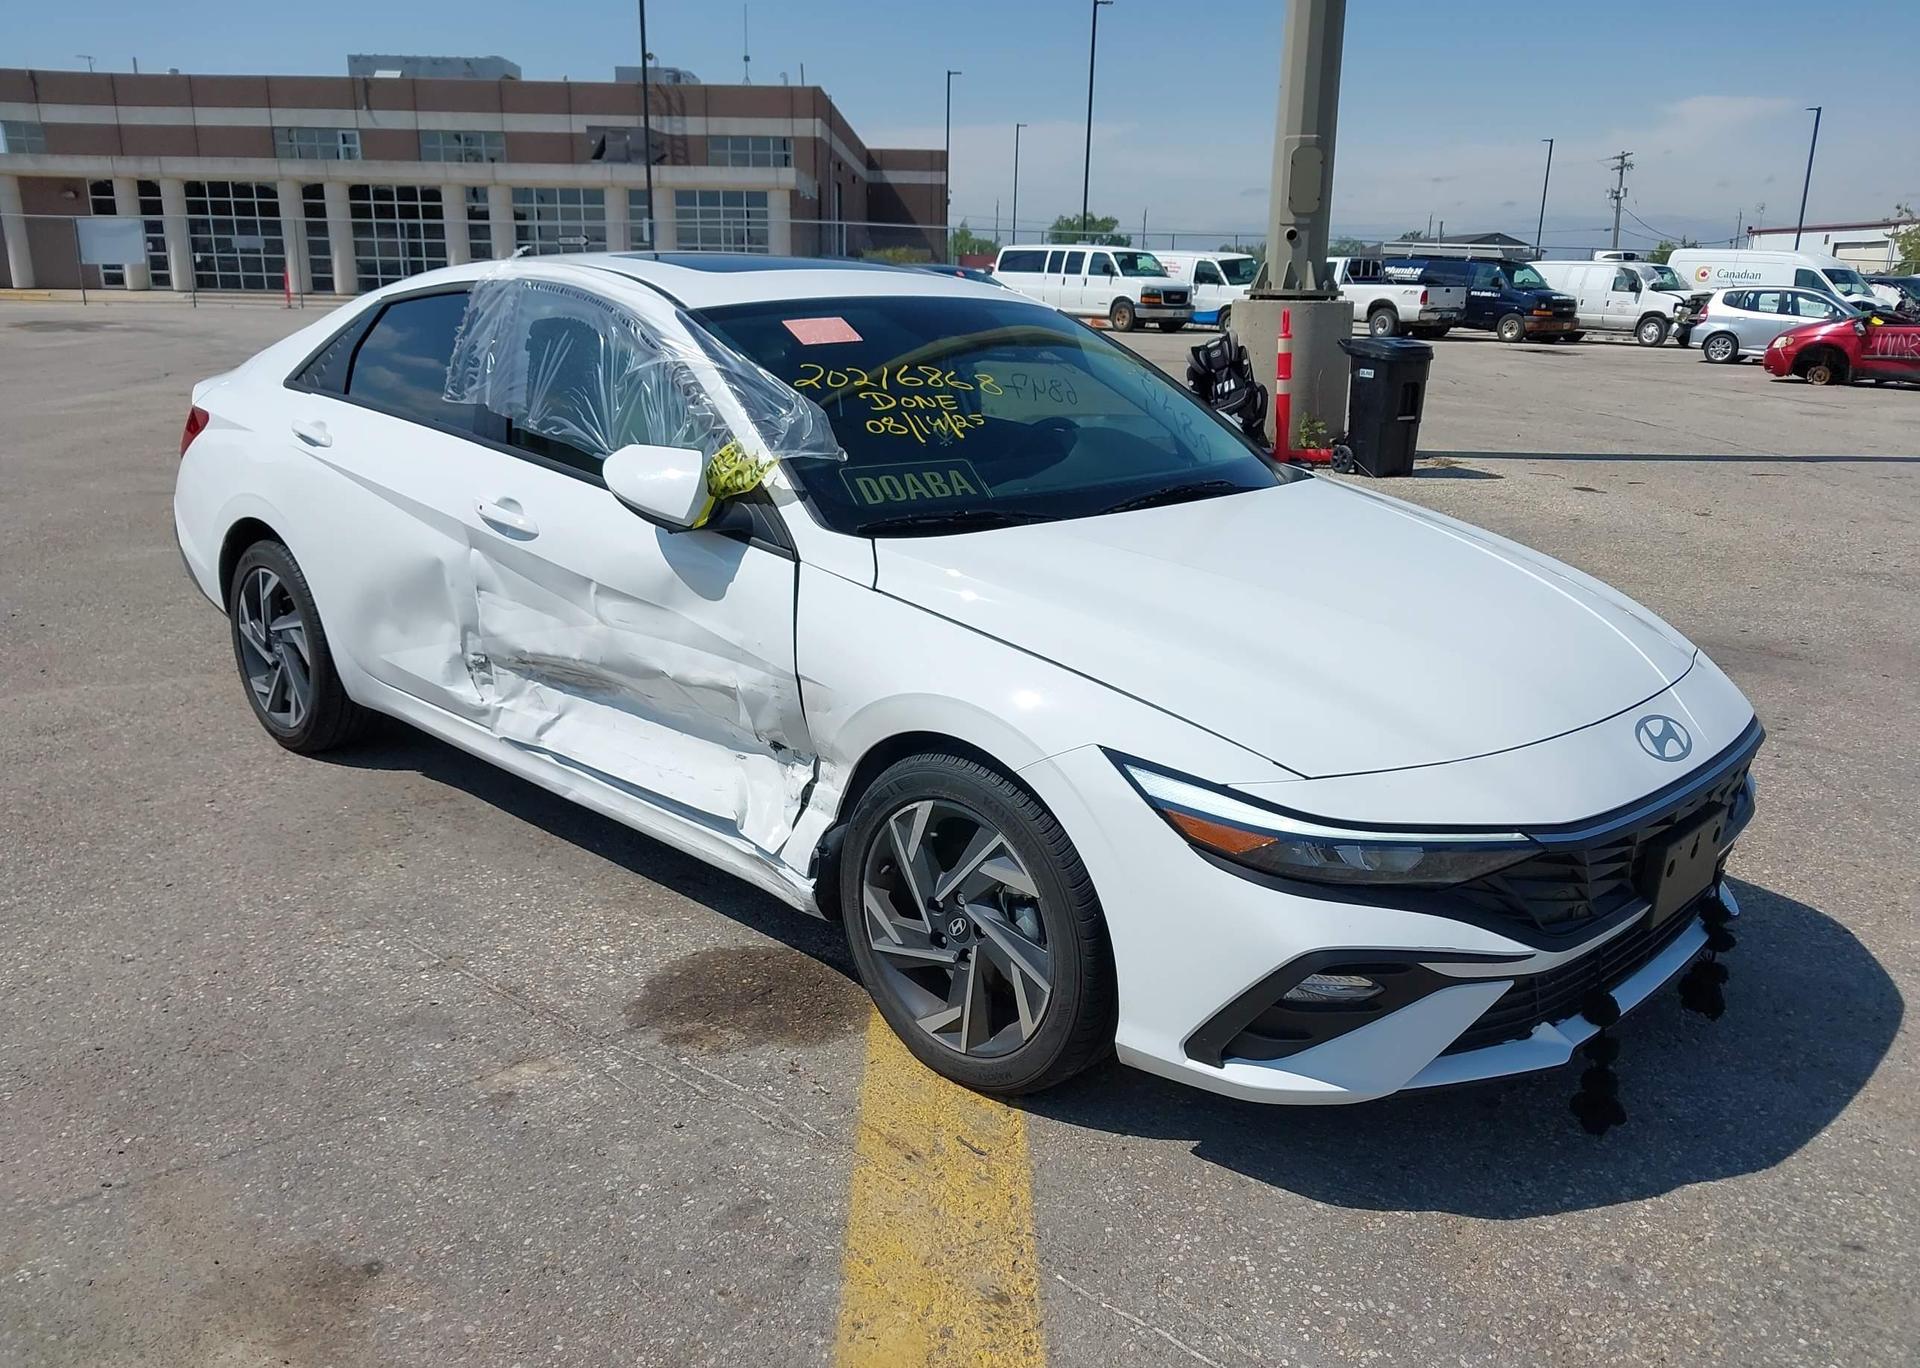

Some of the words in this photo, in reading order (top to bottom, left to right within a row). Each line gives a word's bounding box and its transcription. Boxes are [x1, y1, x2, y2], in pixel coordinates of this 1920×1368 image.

[1716, 268, 1762, 280] Canadian
[793, 363, 1004, 396] 20216868
[858, 392, 959, 411] DONE
[865, 411, 985, 444] 08/14/25
[855, 470, 978, 505] DOABA
